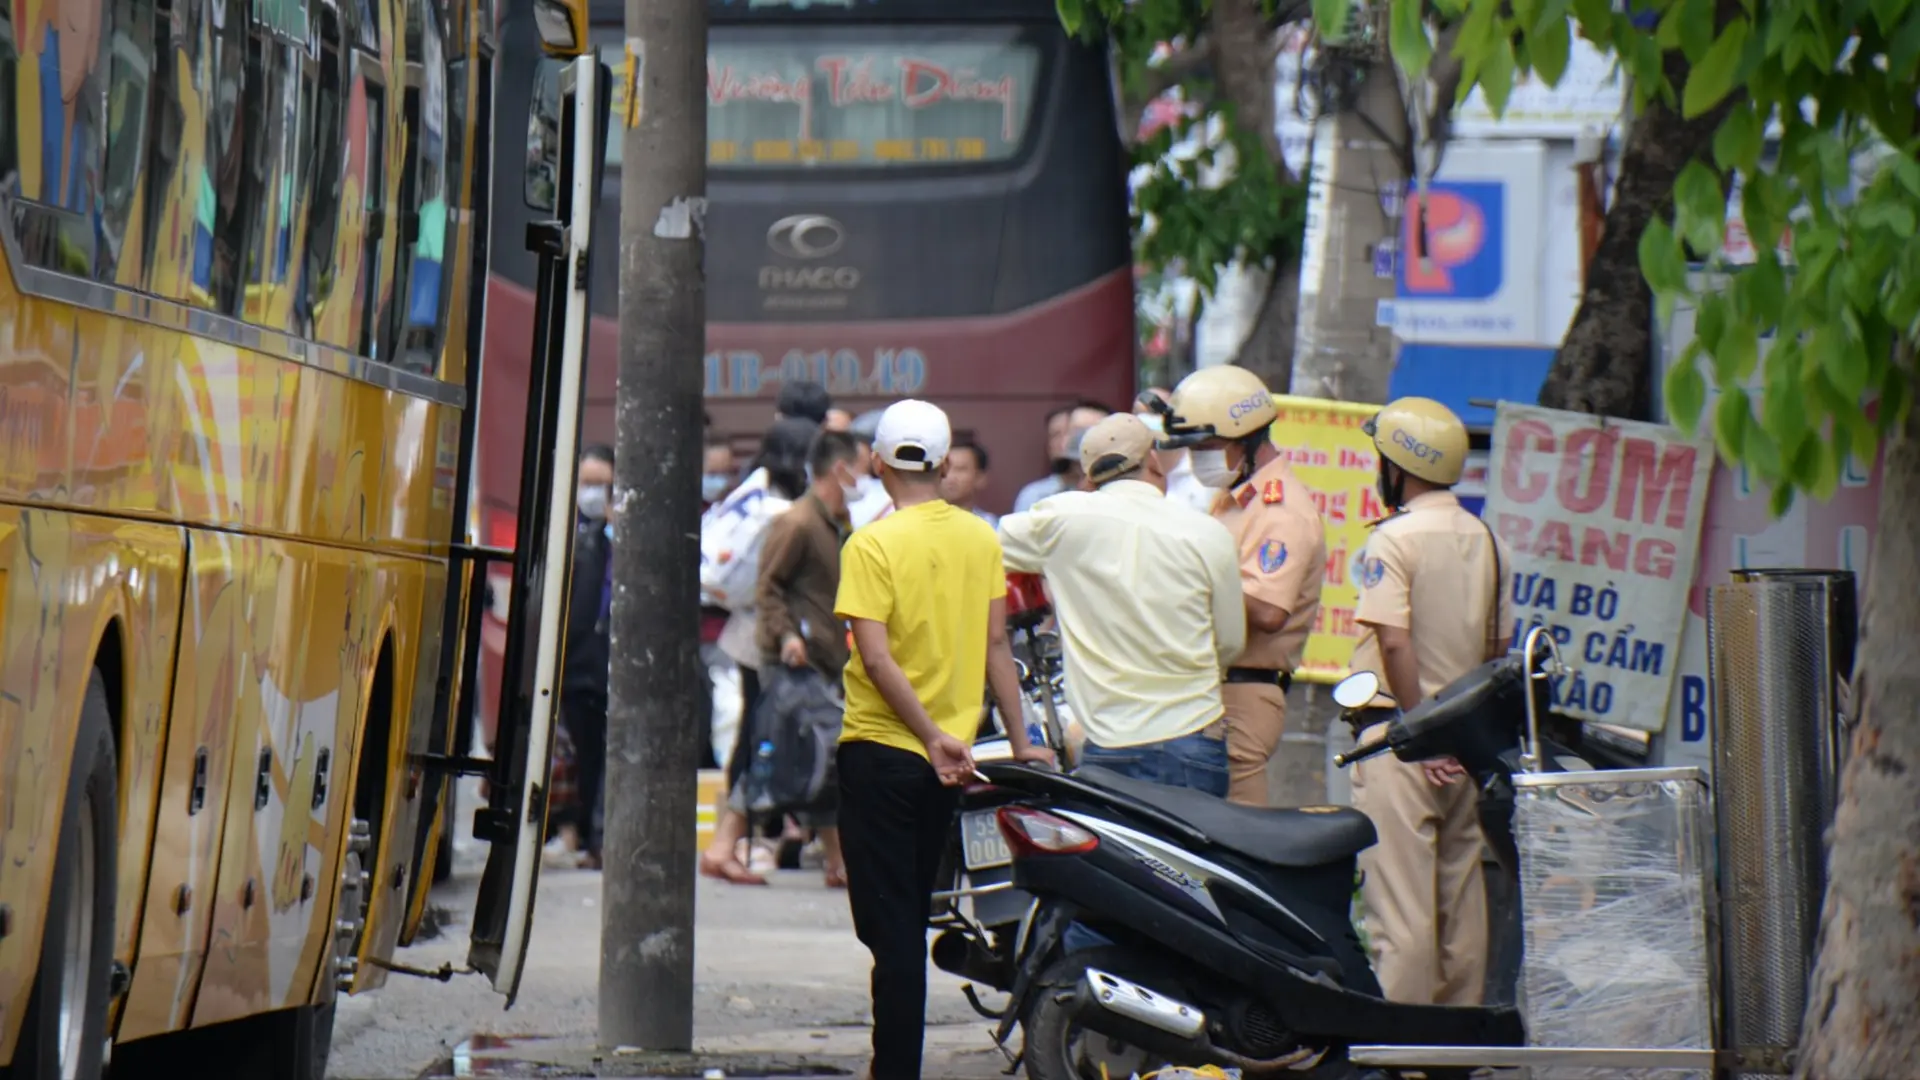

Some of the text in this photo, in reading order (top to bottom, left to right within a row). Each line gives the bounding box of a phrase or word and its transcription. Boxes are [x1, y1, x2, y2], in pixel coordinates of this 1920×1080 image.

[1391, 428, 1444, 467] CSGT
[1502, 419, 1698, 530] CƠM
[1511, 572, 1619, 622] ƯA BÒ
[974, 812, 998, 837] 59
